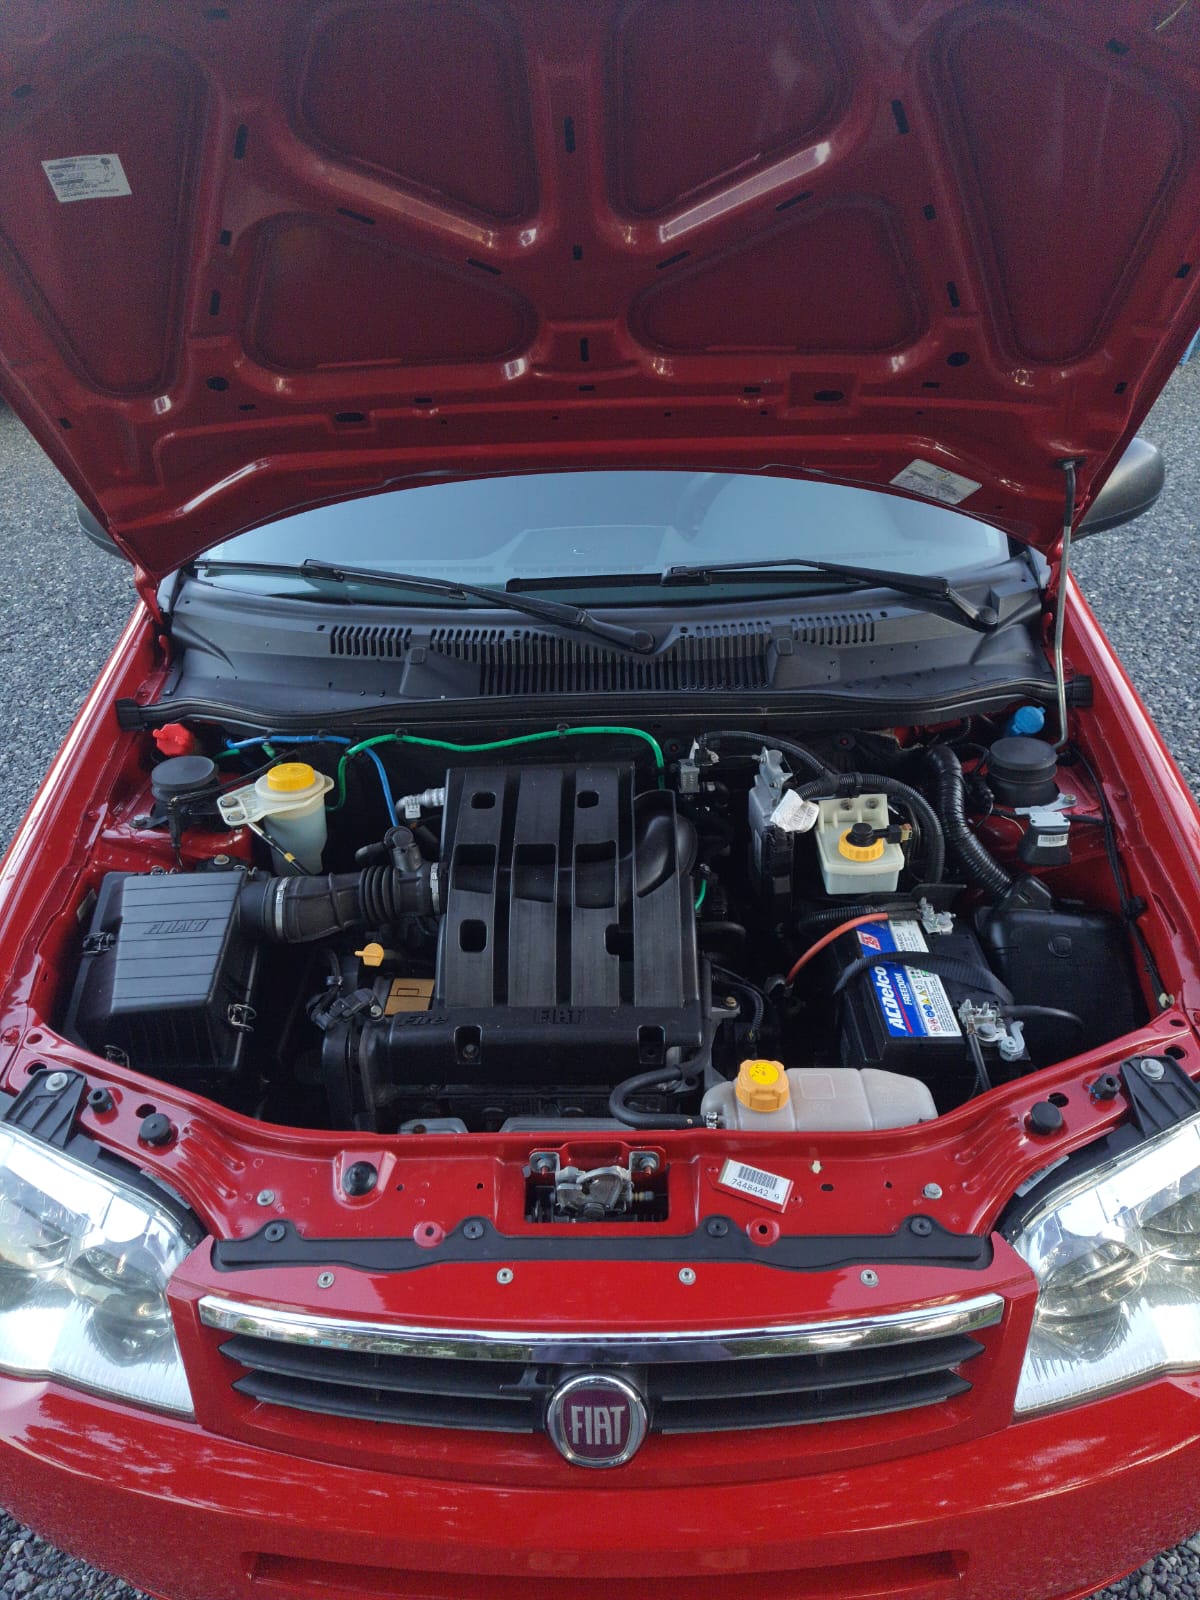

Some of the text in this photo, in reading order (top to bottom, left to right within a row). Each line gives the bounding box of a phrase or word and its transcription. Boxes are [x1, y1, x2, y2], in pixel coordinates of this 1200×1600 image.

[143, 918, 209, 935] FIAT
[873, 966, 907, 1031] ACDelco
[898, 973, 913, 1006] FREEDOM
[570, 1405, 626, 1445] FIAT
